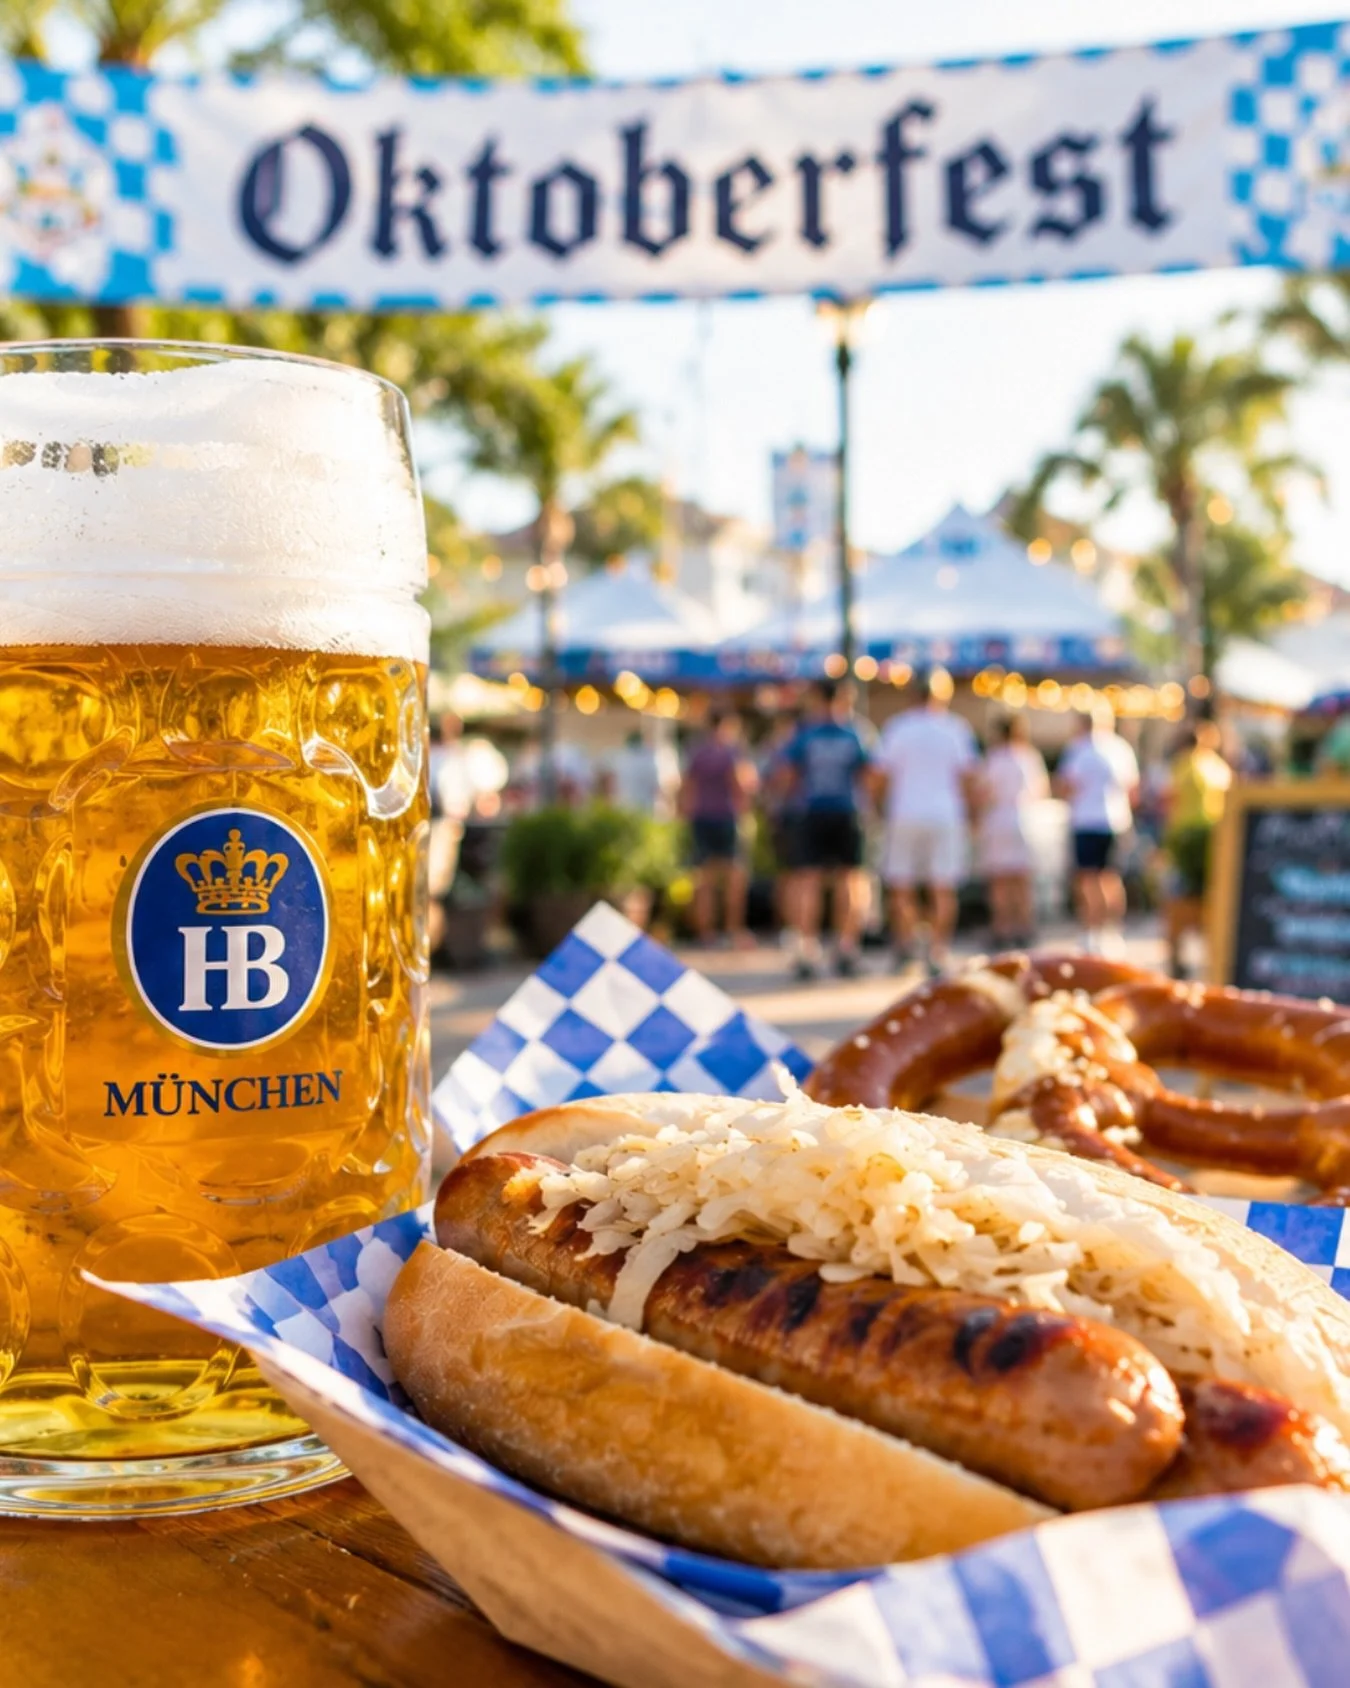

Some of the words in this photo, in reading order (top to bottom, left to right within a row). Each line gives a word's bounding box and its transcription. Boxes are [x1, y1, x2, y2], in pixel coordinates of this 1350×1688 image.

[235, 95, 1176, 264] Oktoberfest
[178, 925, 289, 1011] HB
[103, 1069, 343, 1117] MÜNCHEN
